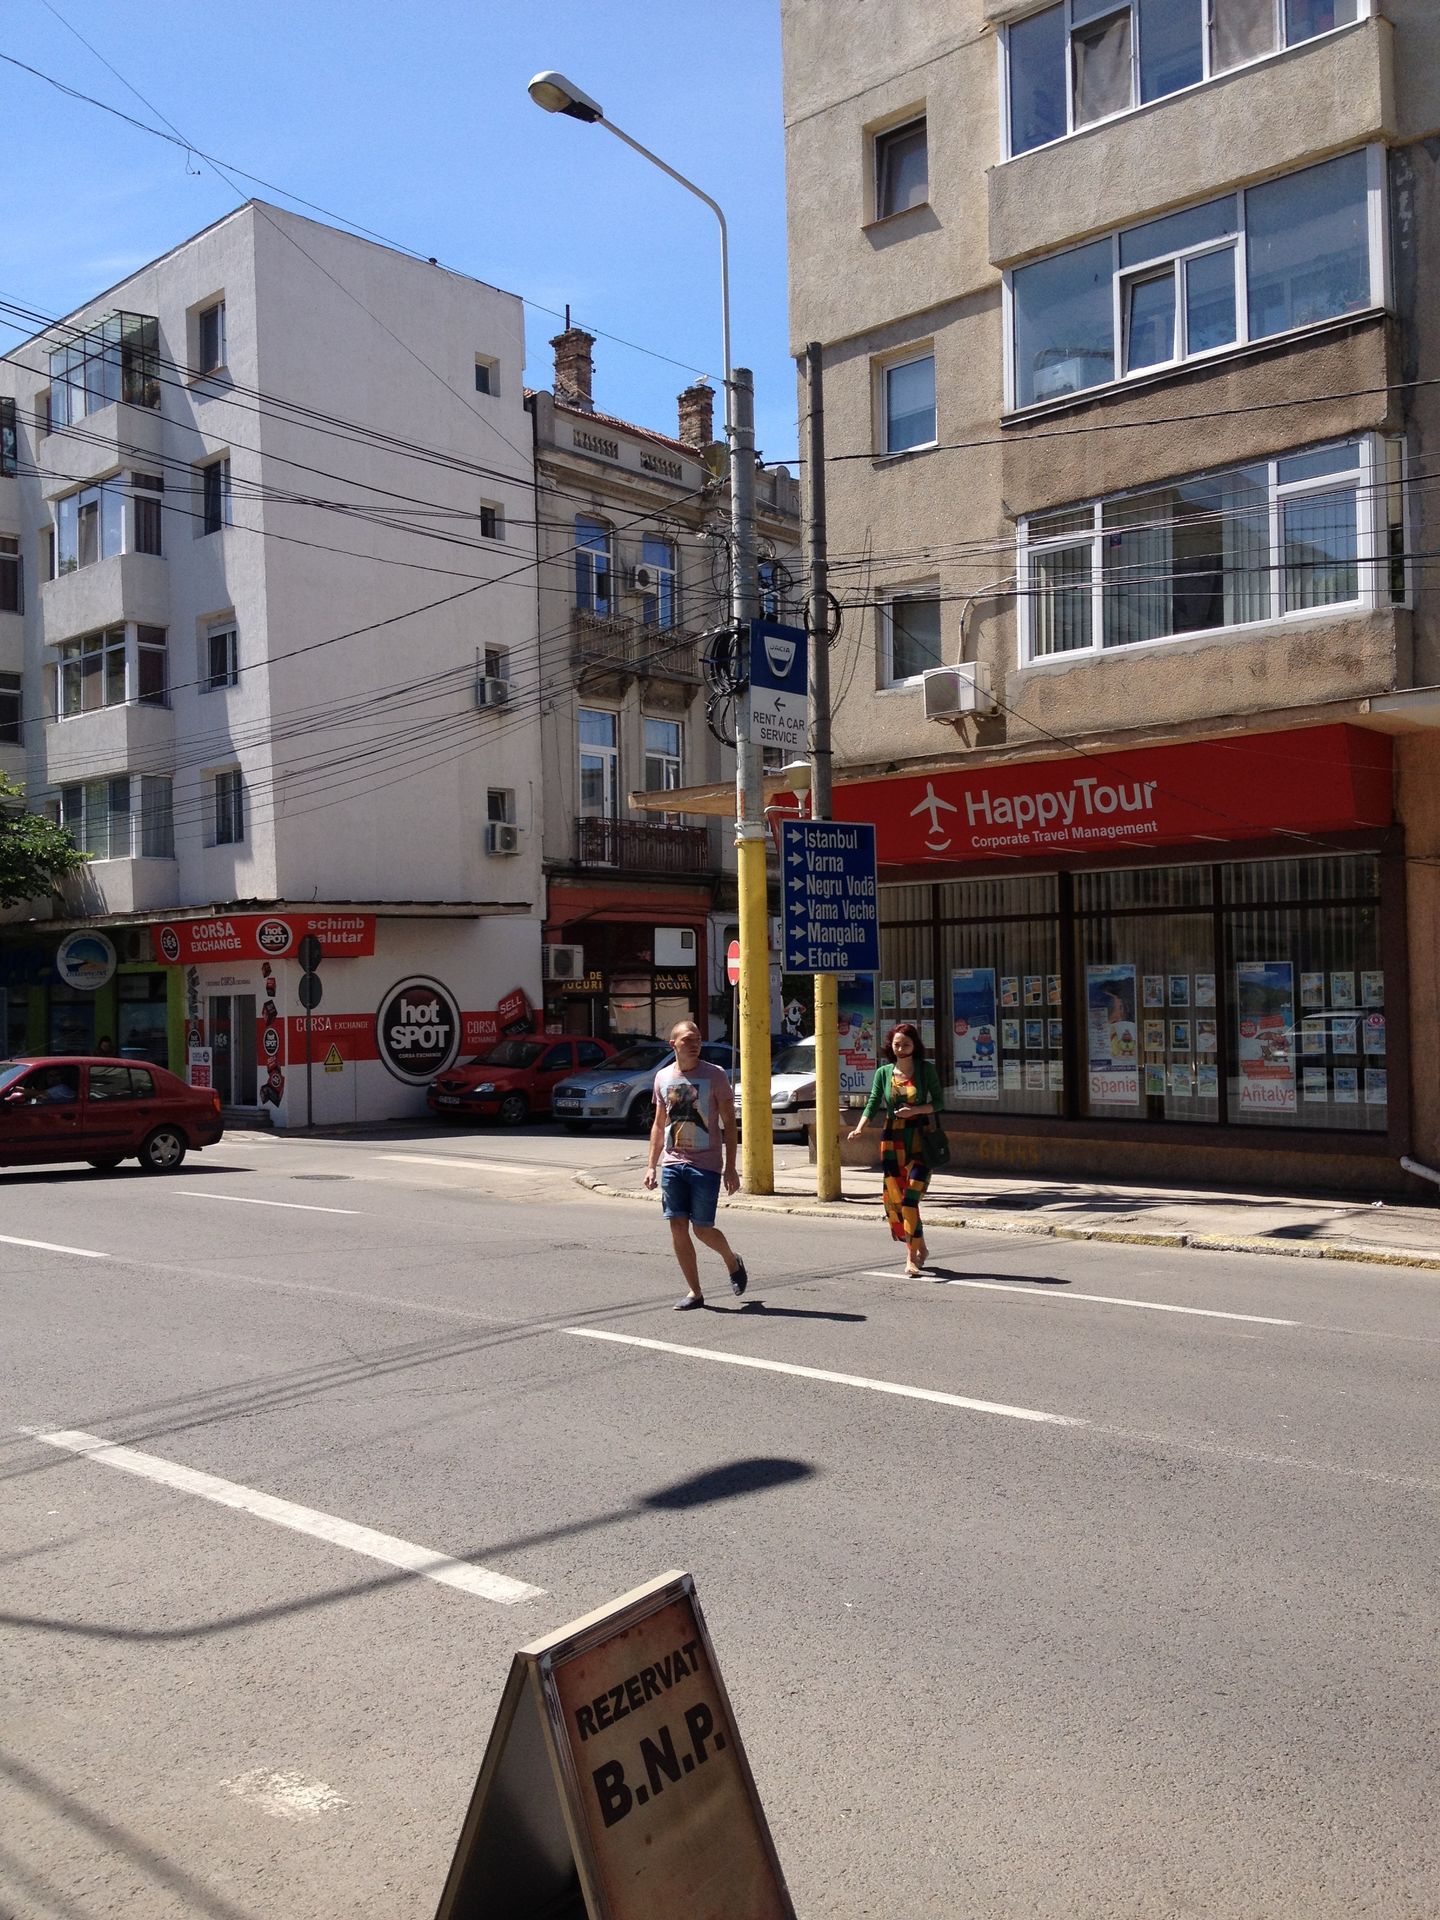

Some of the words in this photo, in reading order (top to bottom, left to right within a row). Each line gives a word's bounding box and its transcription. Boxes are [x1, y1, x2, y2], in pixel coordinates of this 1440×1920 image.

[753, 711, 776, 726] RENT
[779, 717, 785, 727] A
[787, 717, 805, 731] CAR
[760, 727, 798, 745] SERVICE
[804, 827, 858, 850] Istanbul
[971, 835, 1030, 850] Corporate
[1034, 828, 1068, 844] Travel
[1071, 820, 1158, 841] Management
[806, 850, 844, 873] Varna
[806, 874, 843, 899] Negru
[807, 899, 839, 920] Vama
[842, 899, 876, 920] Veche
[265, 926, 283, 935] hot
[307, 918, 364, 930] schimb
[807, 922, 866, 946] Mangalia
[191, 938, 242, 952] EXCHANGE
[261, 934, 288, 944] SPOT
[316, 932, 362, 943] alutar
[808, 947, 849, 968] Eforie
[589, 971, 603, 980] DE
[400, 999, 440, 1024] hot
[500, 996, 522, 1015] SELL
[334, 1020, 369, 1030] EXCHANGE
[467, 1020, 497, 1034] CORSA
[390, 1025, 450, 1050] SPOT
[840, 1071, 865, 1091] Split
[1091, 1078, 1137, 1098] Spania
[1241, 1085, 1295, 1106] Antalya
[575, 1641, 701, 1741] REZERVAT
[592, 1702, 726, 1829] B.N.P.
